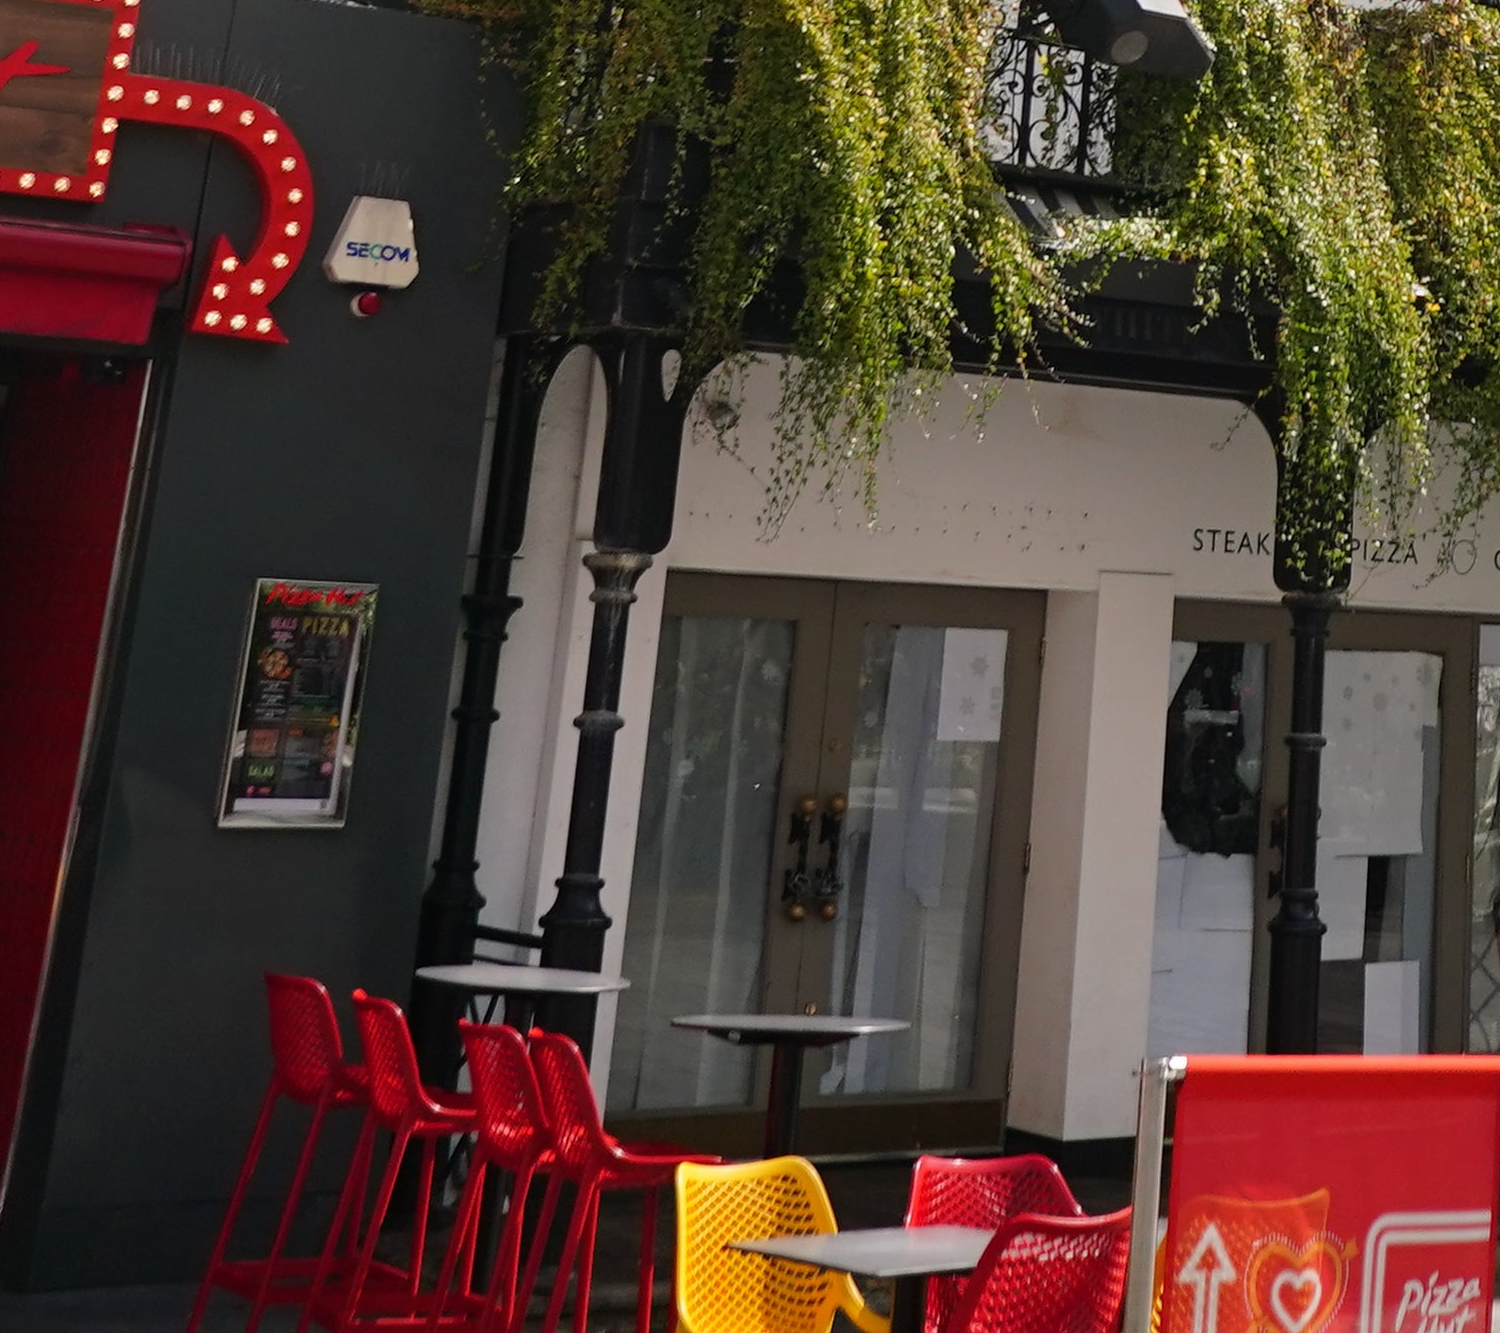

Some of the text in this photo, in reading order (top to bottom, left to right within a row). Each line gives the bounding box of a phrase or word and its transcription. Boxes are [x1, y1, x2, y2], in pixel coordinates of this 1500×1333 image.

[345, 241, 411, 262] SECOM
[1192, 528, 1272, 556] STEAK
[265, 583, 366, 607] Pizza Hut
[301, 616, 350, 637] PIZZA
[1395, 1271, 1481, 1333] Pizza
